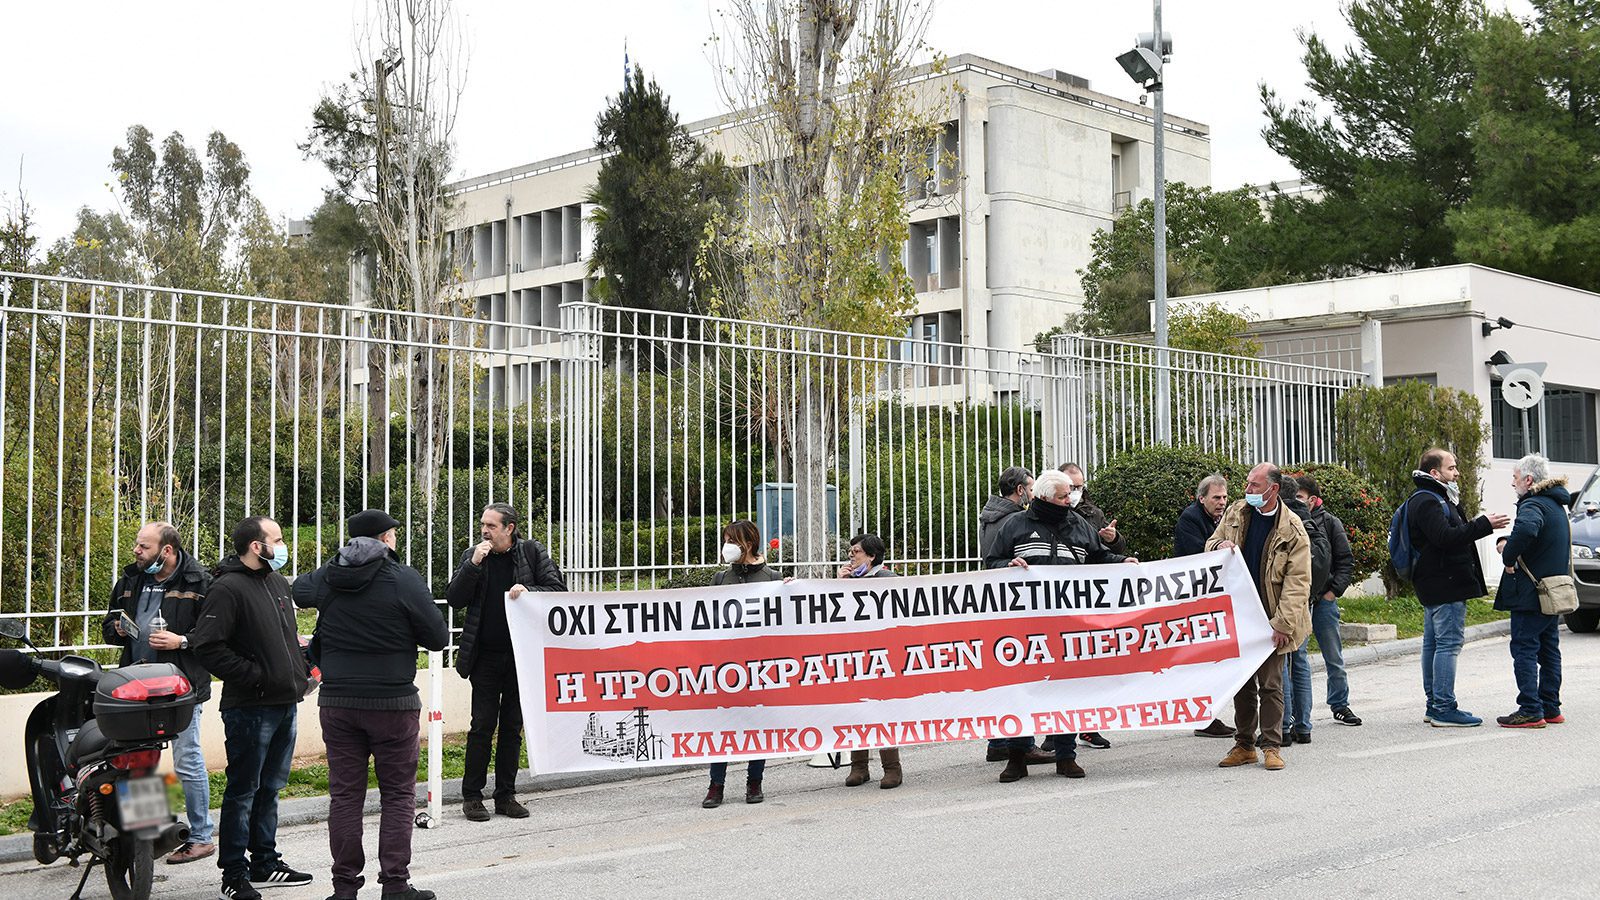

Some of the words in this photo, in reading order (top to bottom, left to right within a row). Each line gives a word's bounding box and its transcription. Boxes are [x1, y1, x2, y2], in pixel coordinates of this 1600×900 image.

[547, 605, 595, 637] ΟΧΙ
[604, 601, 683, 635] ΣΤΗΝ
[691, 595, 784, 631] ΔΙΩΞΗ
[789, 591, 847, 625] ΤΗΣ
[852, 578, 1112, 622] ΣΥΝΔΙΚΑΛΙΣΤΙΚΗΣ
[1118, 564, 1225, 608] ΔΡΑΣΗΣ
[554, 671, 588, 705] Η
[596, 648, 896, 701] ΤΡΟΜΟΚΡΑΤΙΑ
[901, 638, 984, 677] ΔΕΝ
[993, 633, 1056, 667] ΘΑ
[1060, 610, 1232, 663] ΠΕΡΑΣΕΙ
[671, 726, 823, 758] ΚΛΑΔΙΚΟ
[832, 713, 1023, 750] ΣΥΝΔΙΚΑΤΟ
[1031, 695, 1213, 735] ΕΝΕΡΓΕΙΑΣ
